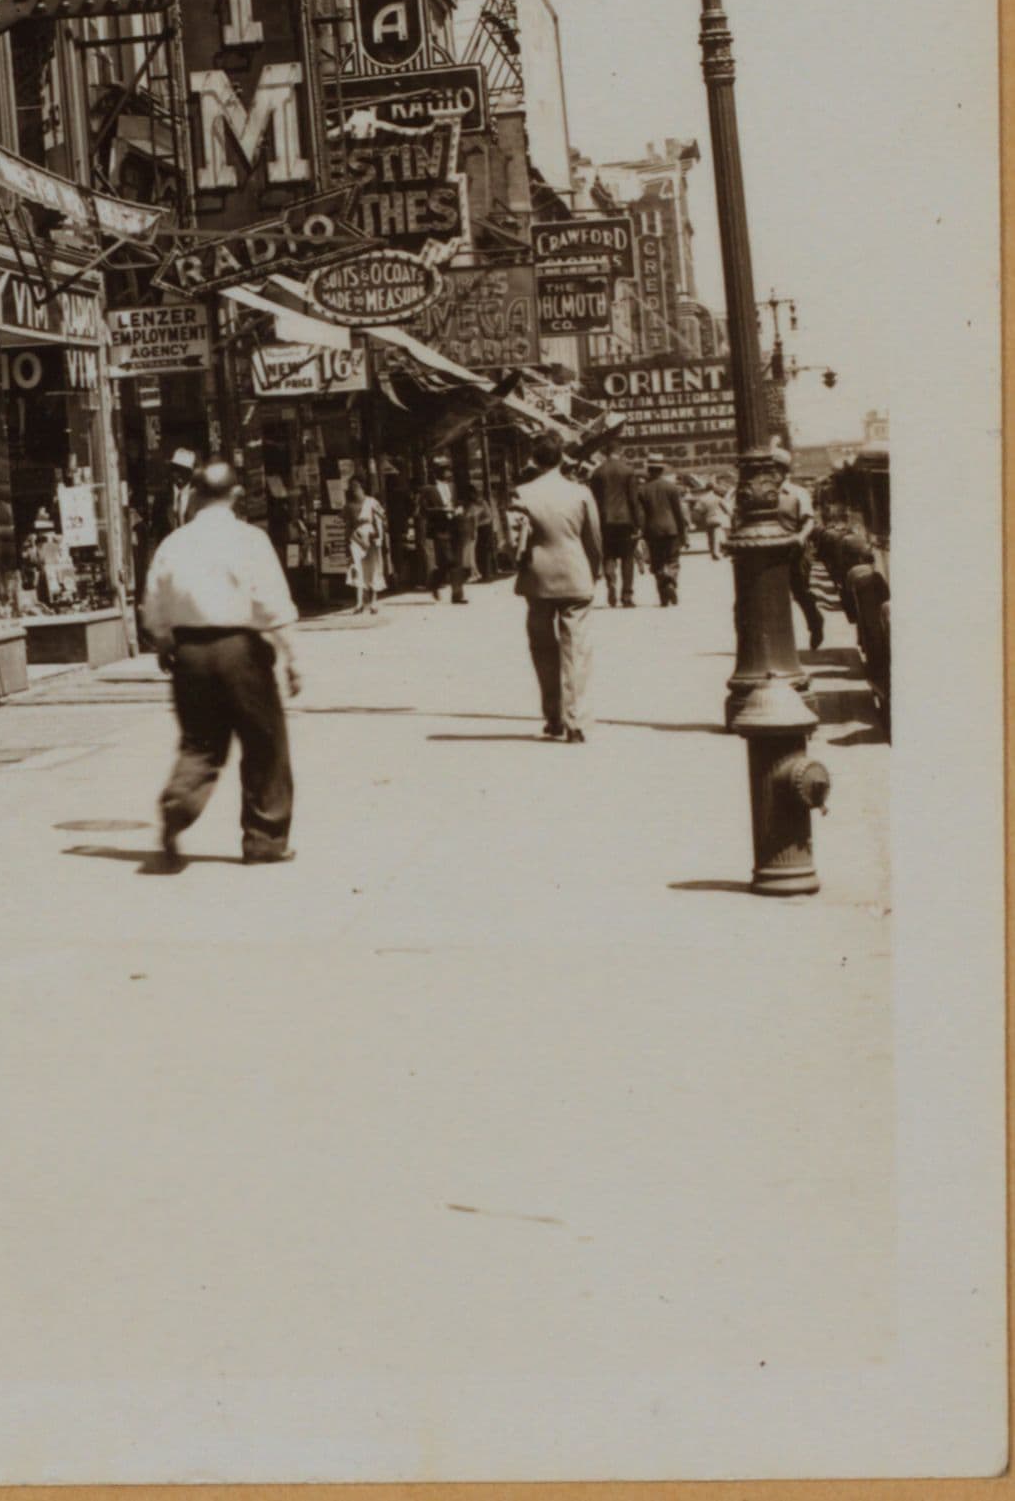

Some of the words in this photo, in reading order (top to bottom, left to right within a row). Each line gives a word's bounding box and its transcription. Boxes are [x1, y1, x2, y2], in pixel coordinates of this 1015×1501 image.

[176, 214, 335, 287] RADIO
[537, 227, 628, 256] CRAWFORD
[321, 289, 352, 311] MADE
[365, 285, 426, 313] MEASURE
[545, 283, 574, 293] THE
[12, 280, 49, 330] VIM
[117, 307, 196, 329] LENZER
[111, 326, 206, 347] EMPLOYMENT
[130, 343, 189, 358] AGENCY
[66, 349, 98, 389] VIM
[603, 364, 726, 397] ORIENT
[641, 422, 696, 436] SHIRLEY
[702, 418, 736, 431] TEMP
